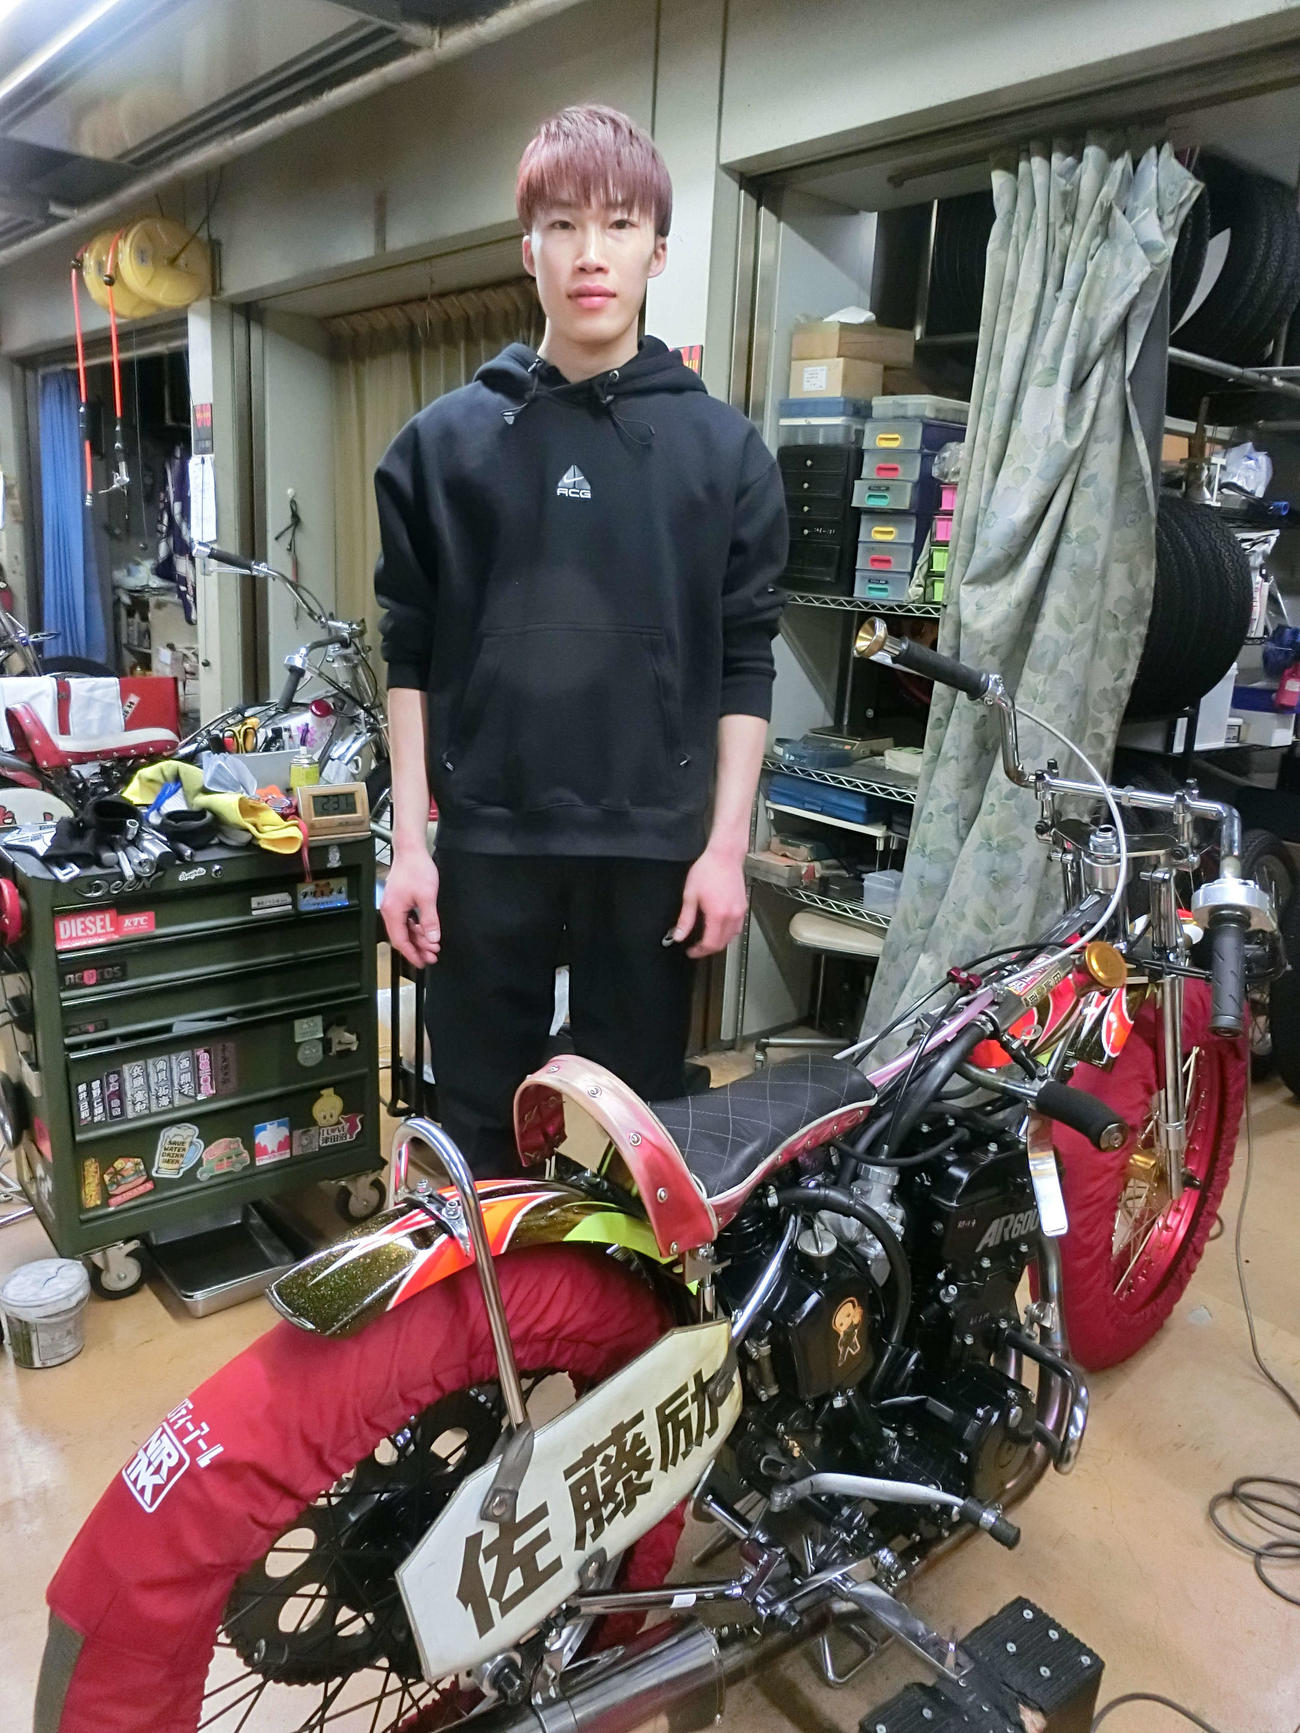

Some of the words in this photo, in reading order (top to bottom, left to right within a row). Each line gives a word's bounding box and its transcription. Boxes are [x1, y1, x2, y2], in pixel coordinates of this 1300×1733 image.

[556, 487, 592, 499] ACG
[60, 914, 114, 939] DIESEL
[123, 916, 148, 927] KTC
[456, 1367, 735, 1639] 佐藤励
